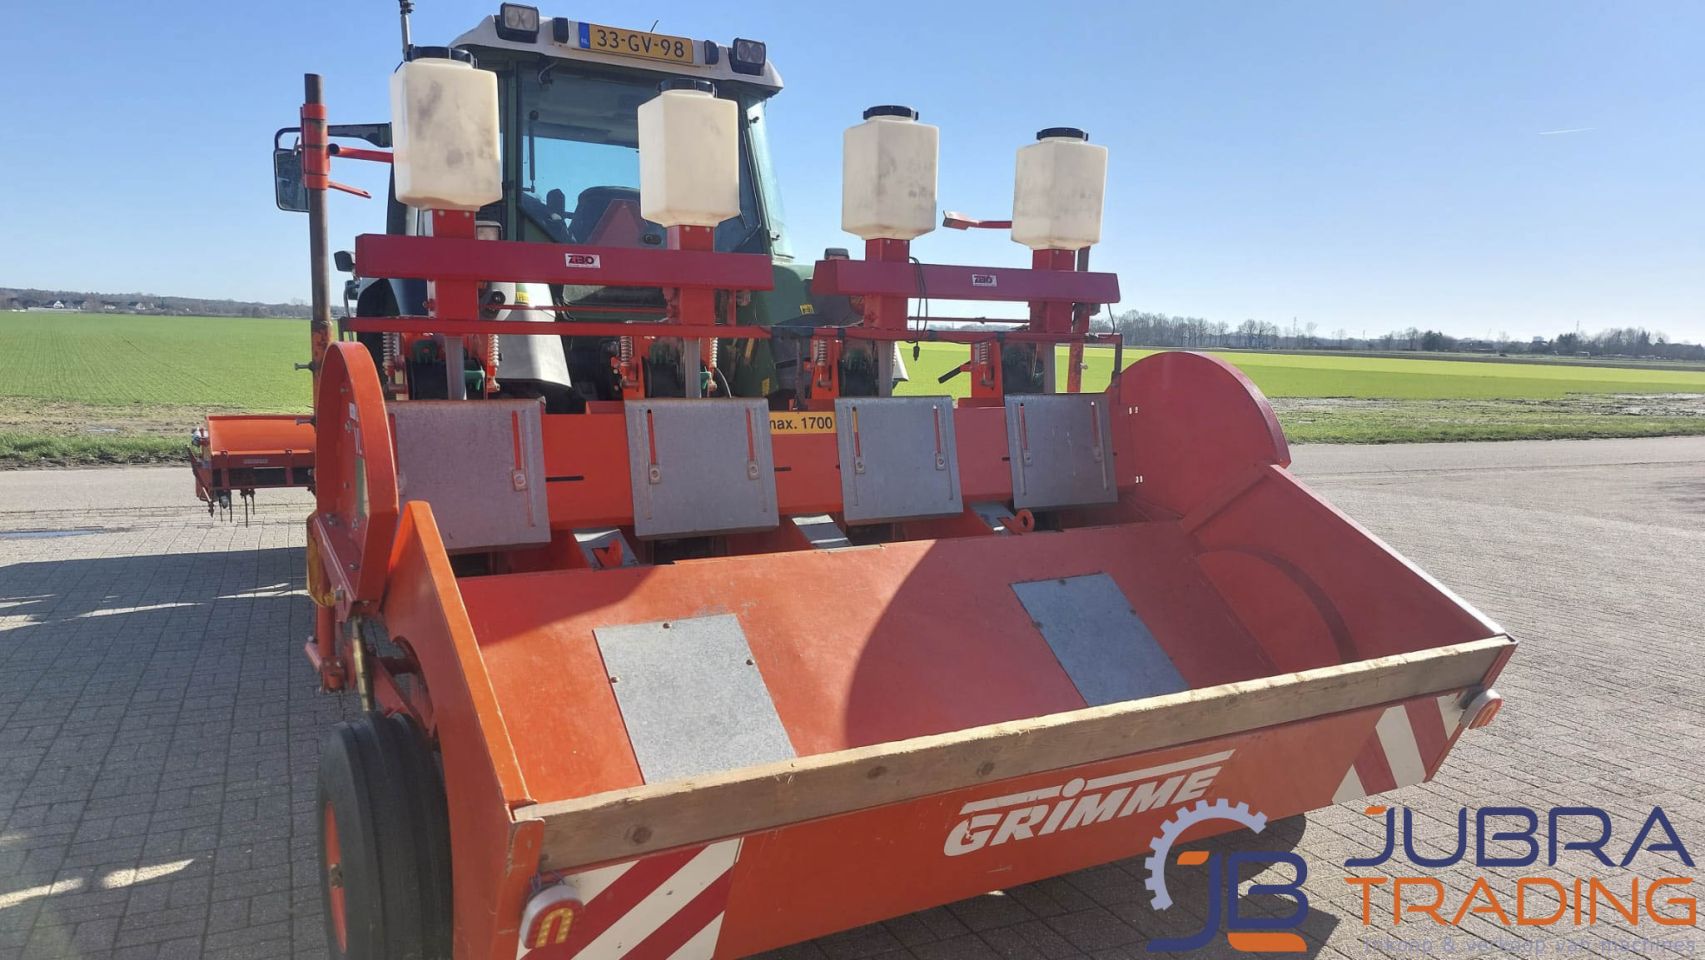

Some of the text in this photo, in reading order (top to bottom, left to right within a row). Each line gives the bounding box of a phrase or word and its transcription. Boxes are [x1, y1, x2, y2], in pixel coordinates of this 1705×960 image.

[597, 29, 684, 57] 33-GV-98
[801, 416, 833, 430] 1700
[944, 762, 1224, 857] GRIMME
